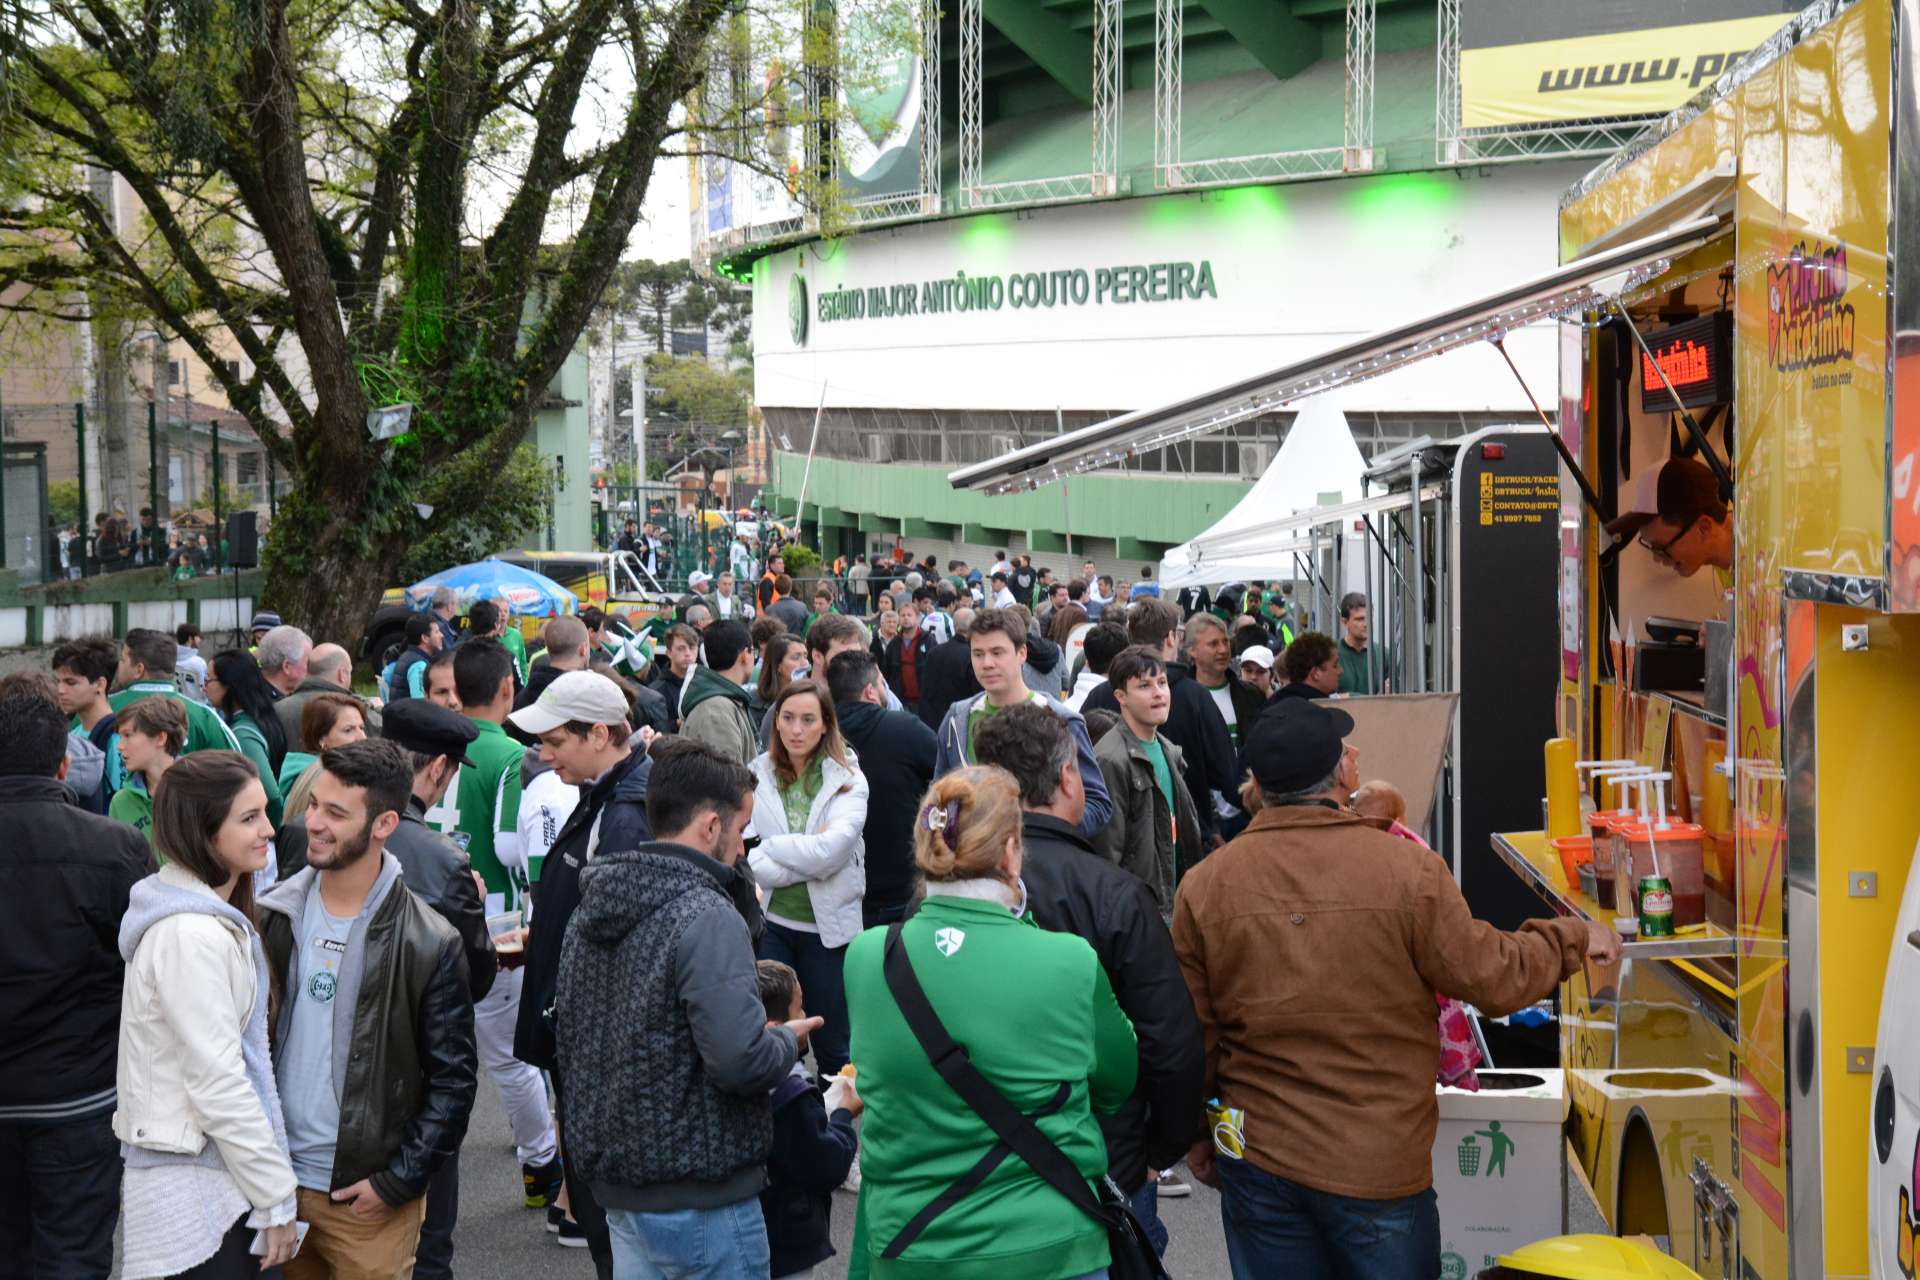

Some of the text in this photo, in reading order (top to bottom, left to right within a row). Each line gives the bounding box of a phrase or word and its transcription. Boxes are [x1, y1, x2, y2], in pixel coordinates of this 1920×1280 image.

[817, 260, 1218, 322] ESTÁDIO MAJOR ANTÔNIO COUTO PEREIRA
[1190, 591, 1200, 610] 7
